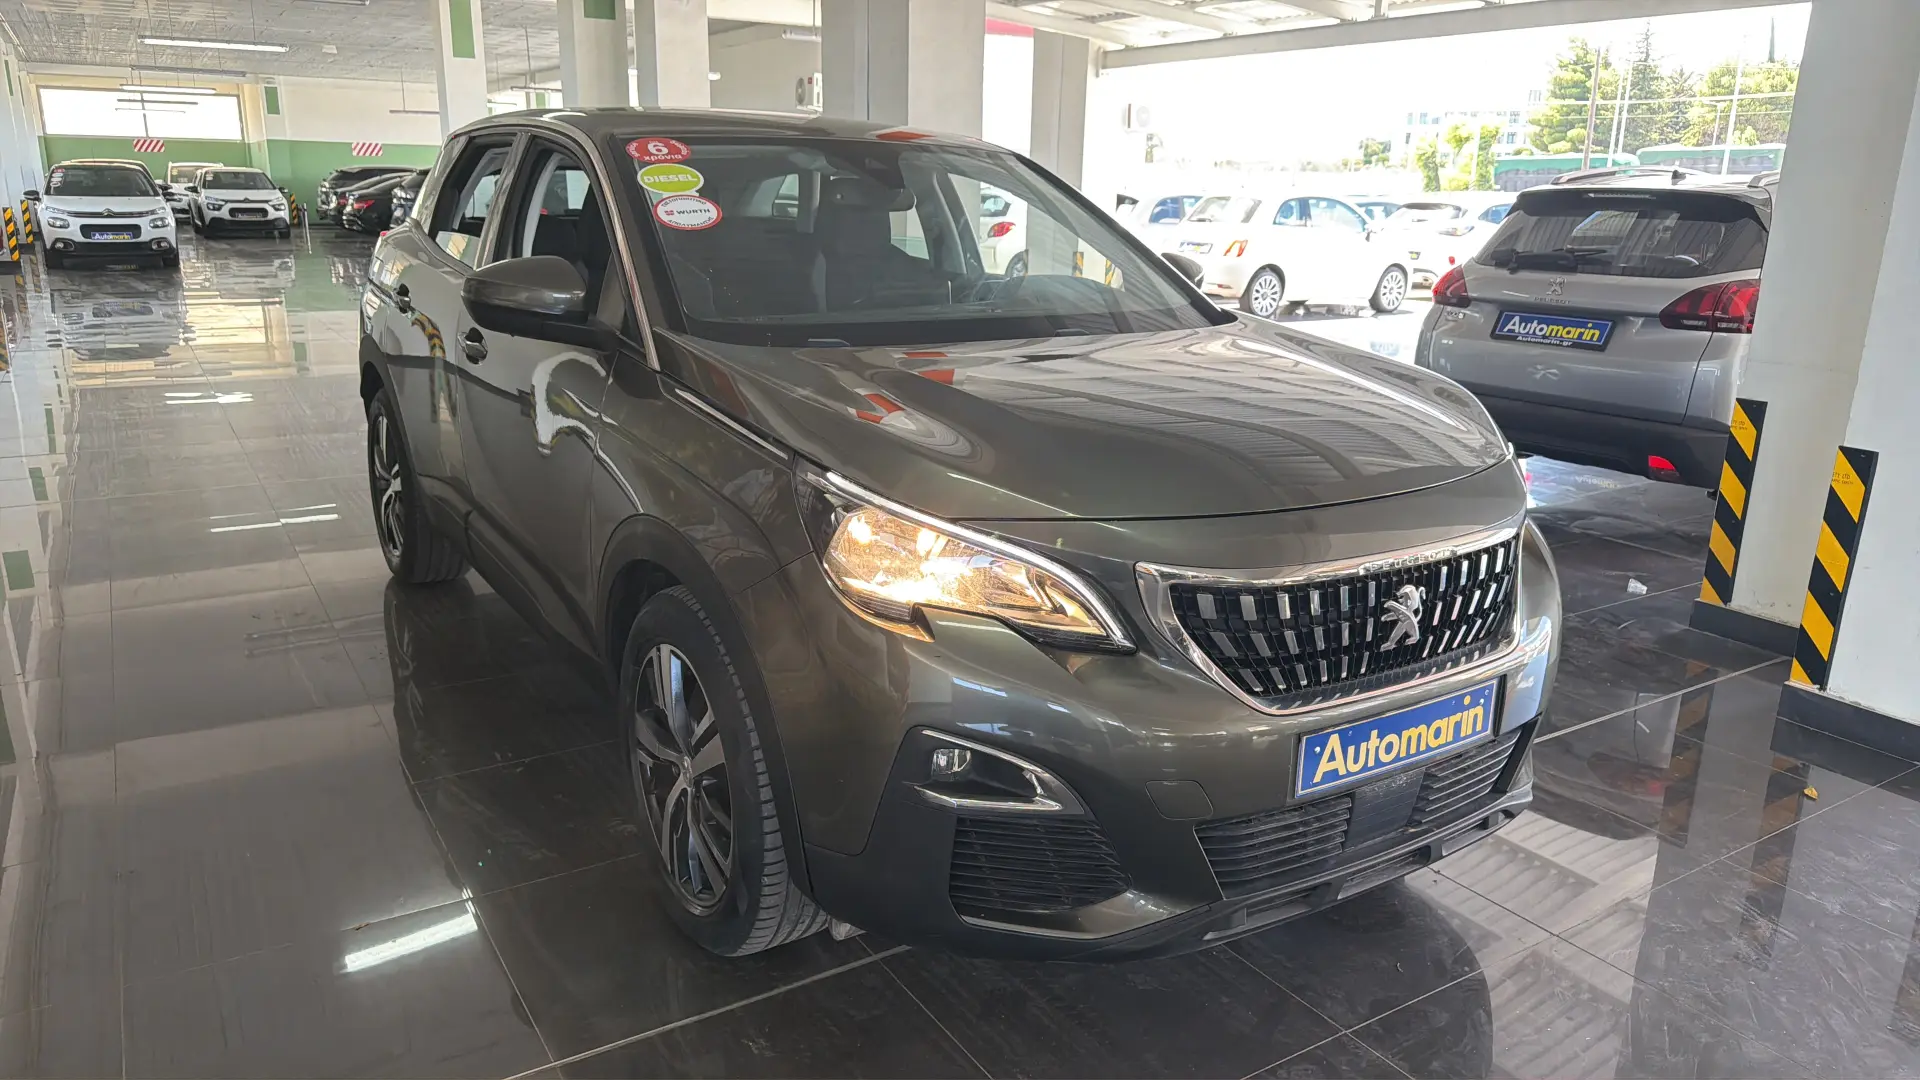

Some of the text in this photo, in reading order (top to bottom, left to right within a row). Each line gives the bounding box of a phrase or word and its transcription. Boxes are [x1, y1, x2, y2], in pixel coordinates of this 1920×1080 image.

[647, 142, 669, 155] 6
[643, 174, 698, 183] DIESEL
[1503, 315, 1601, 342] Automarin
[1516, 335, 1573, 346] Automarin.gr
[1312, 695, 1485, 784] Automarin
